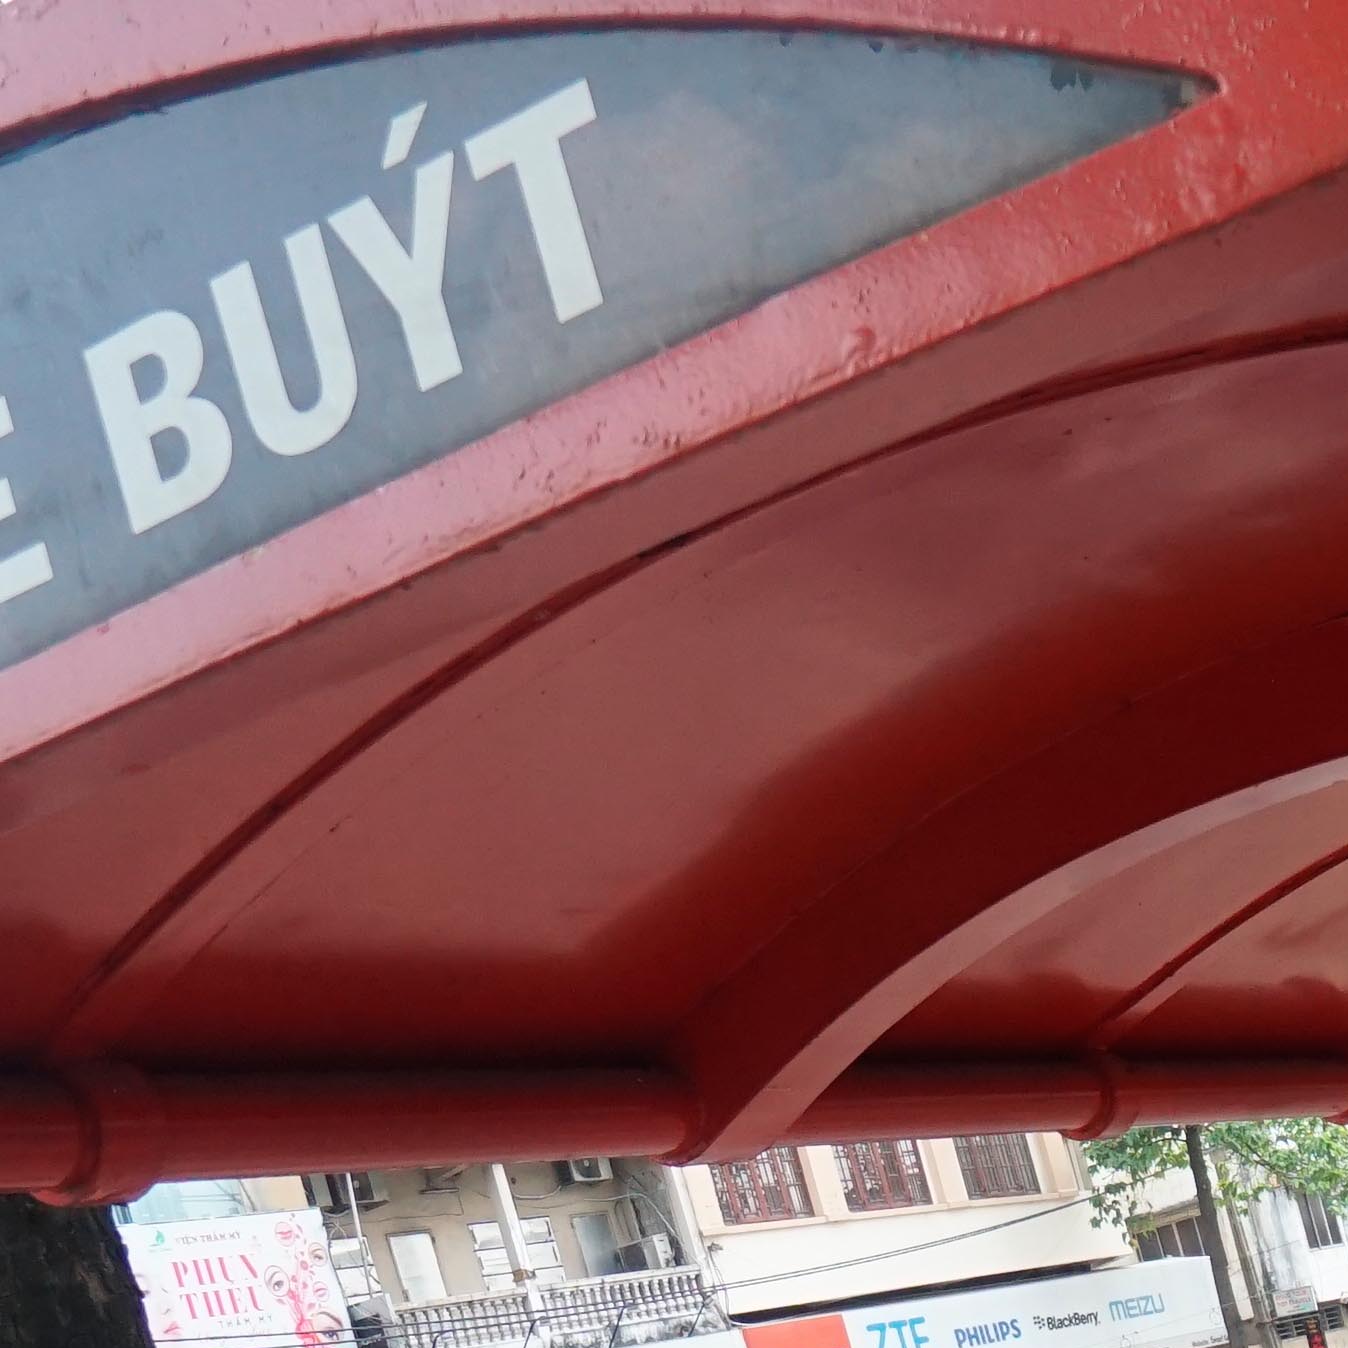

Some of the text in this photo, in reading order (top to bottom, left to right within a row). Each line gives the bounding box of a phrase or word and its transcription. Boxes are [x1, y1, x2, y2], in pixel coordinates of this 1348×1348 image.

[85, 78, 604, 534] BUÝT
[1046, 1311, 1100, 1331] BlackBerry
[1108, 1293, 1166, 1322] MEIZU
[953, 1318, 1022, 1348] PHILIPS
